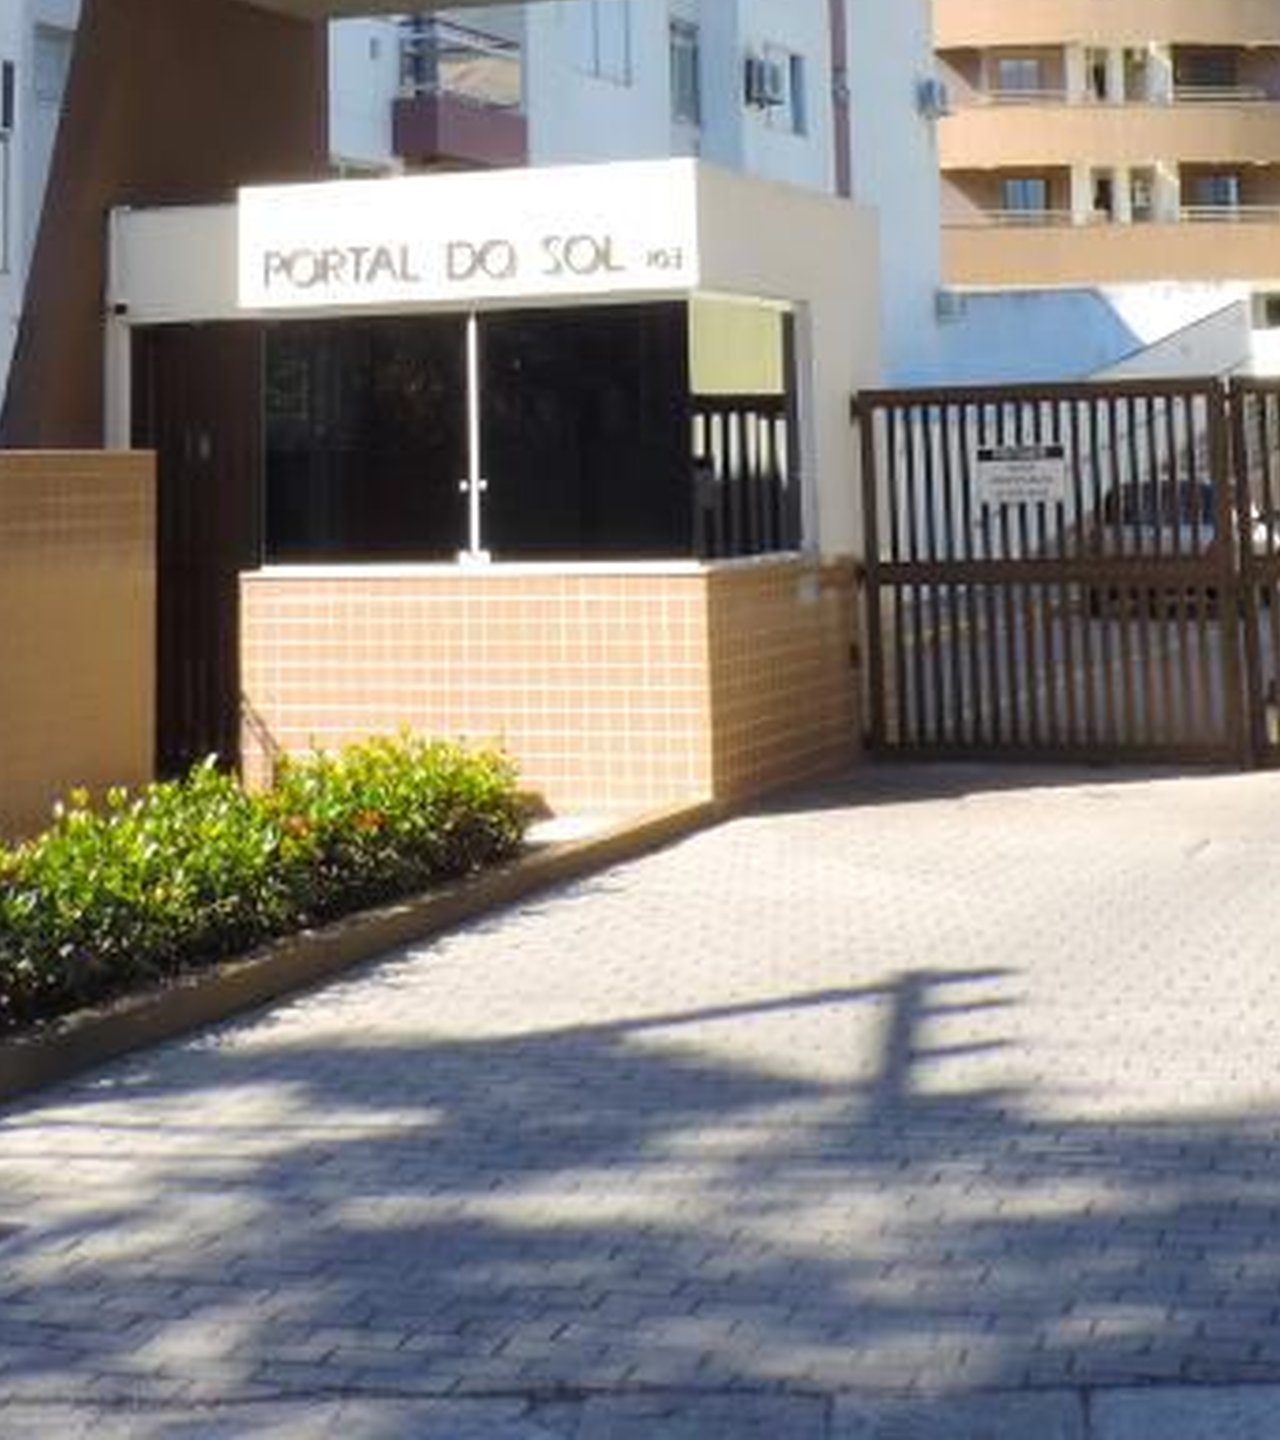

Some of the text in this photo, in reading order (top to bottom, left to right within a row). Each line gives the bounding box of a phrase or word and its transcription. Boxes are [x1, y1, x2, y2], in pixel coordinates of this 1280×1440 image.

[264, 244, 421, 289] PORTAL
[447, 239, 517, 281] DO
[540, 234, 627, 275] SOL
